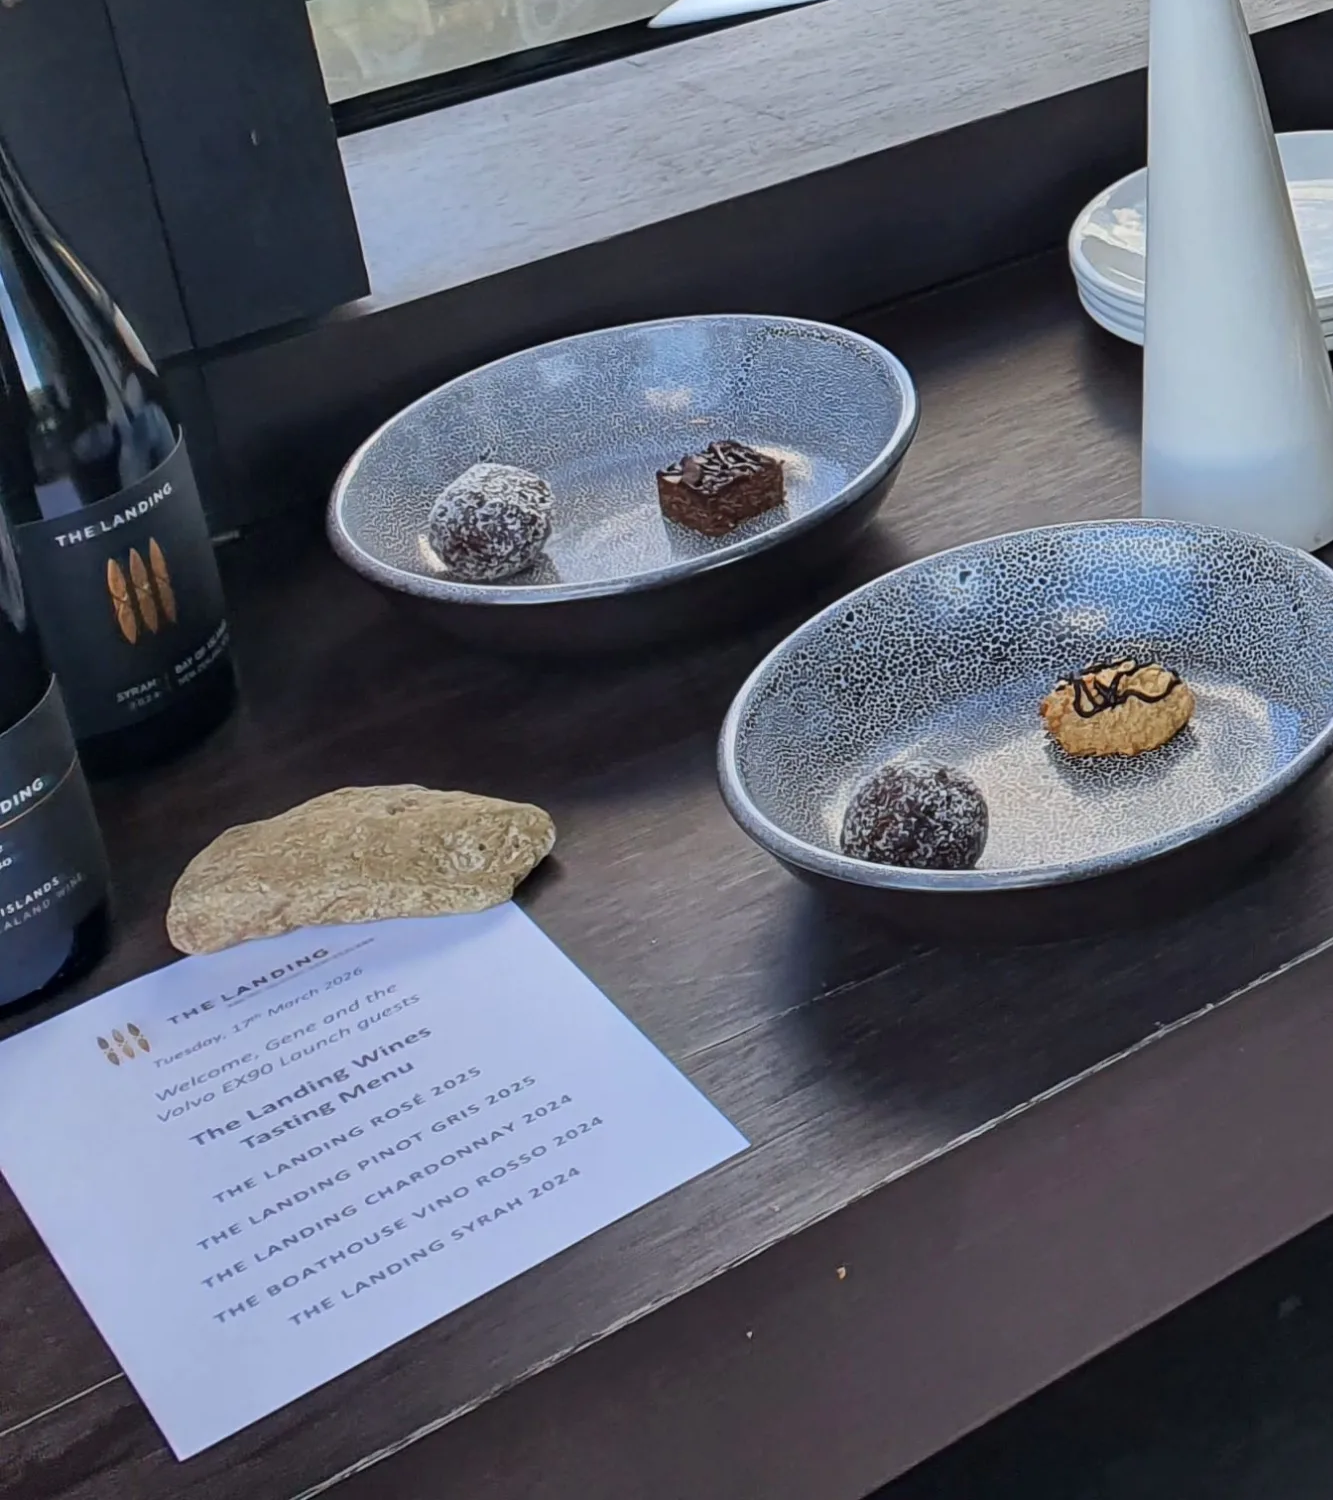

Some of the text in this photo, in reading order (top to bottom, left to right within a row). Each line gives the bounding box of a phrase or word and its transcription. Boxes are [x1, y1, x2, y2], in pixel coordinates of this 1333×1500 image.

[55, 481, 174, 548] THE LANDING
[0, 777, 44, 815] DING
[0, 876, 60, 918] ISLANDS
[0, 899, 51, 935] ALAND
[153, 1032, 228, 1069] Tuesday,
[268, 987, 320, 1017] March
[324, 966, 363, 991] 2026
[154, 982, 398, 1103] Welcome, Gene and the
[166, 1000, 215, 1025] THE
[220, 948, 329, 1002] LANDING
[156, 993, 421, 1123] Volvo EX90 Launch guests
[188, 1026, 432, 1146] The Landing Wines
[239, 1062, 415, 1149] Tasting Menu
[196, 1075, 537, 1250] THE LANDING PINOT GRIS 2025
[201, 1094, 573, 1288] THE LANDING CHARDONNAY 2024
[212, 1066, 482, 1203] THE LANDING ROSÉ 2025
[213, 1116, 604, 1323] THE BOATHOUSE VINO ROSSO 2024
[288, 1167, 581, 1325] THE LANDING SYRAH 2024
